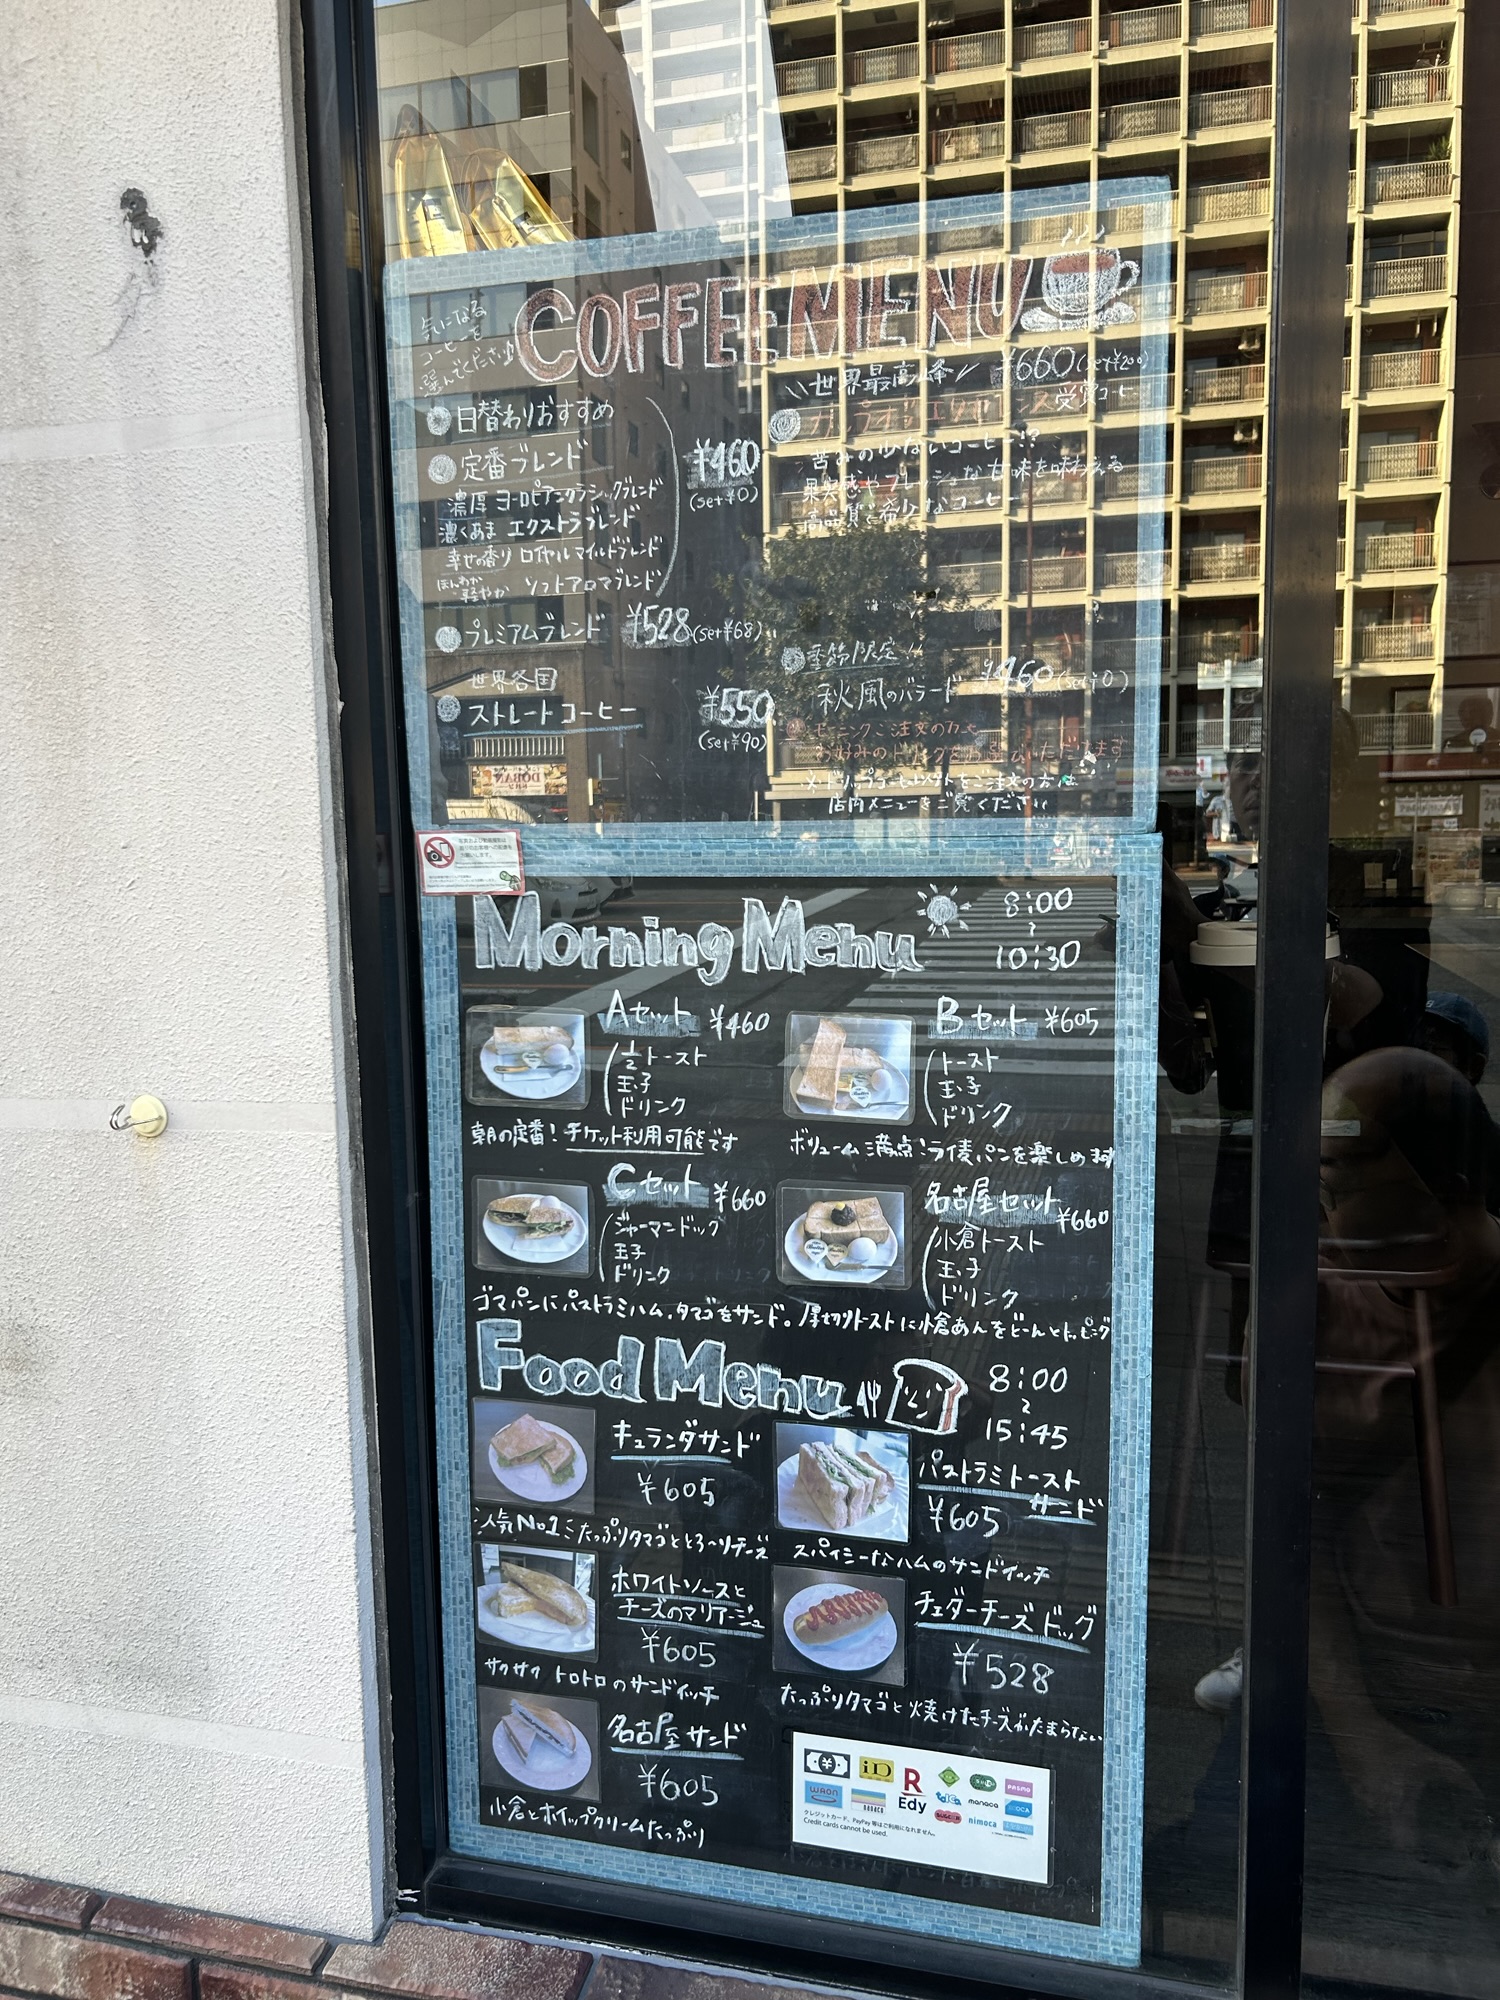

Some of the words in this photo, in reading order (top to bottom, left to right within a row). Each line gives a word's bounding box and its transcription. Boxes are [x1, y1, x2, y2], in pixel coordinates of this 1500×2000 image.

[515, 276, 780, 383] COFFEE
[788, 254, 1033, 360] MENU
[457, 395, 615, 433] 日替わりおすすめ
[461, 439, 589, 482] 定番ブレンド
[693, 438, 761, 483] ¥460
[465, 612, 606, 648] プレミアムブレンド
[626, 602, 693, 645] ¥528
[470, 667, 559, 694] 世界各国
[468, 699, 637, 726] ストレートコーヒー
[702, 684, 775, 725] ¥550
[1004, 887, 1073, 918] 8:00
[473, 891, 734, 986] Morning
[741, 895, 925, 976] Menu
[996, 940, 1081, 971] 10:30
[606, 989, 692, 1028] Aセット
[710, 1004, 771, 1041] ¥460
[936, 995, 1028, 1037] Bセット
[1045, 1005, 1099, 1036] ¥605
[942, 1047, 999, 1076] トースト
[622, 1096, 686, 1119] ドリンク
[942, 1102, 1012, 1129] ドリンク
[607, 1162, 702, 1200] Cセット
[713, 1181, 767, 1213] ¥660
[924, 1176, 1065, 1217] 名古屋セット
[1055, 1207, 1110, 1234] ¥660
[934, 1221, 1045, 1254] 小倉トースト
[615, 1263, 671, 1287] ドリンク
[942, 1283, 1019, 1310] ドリンク
[476, 1318, 647, 1403] Food
[654, 1336, 855, 1420] Menu
[989, 1364, 1068, 1393] 8:00
[612, 1419, 761, 1458] キュランダサンド
[985, 1416, 1069, 1450] 15:45
[919, 1449, 1081, 1492] パストラミトースト
[637, 1472, 716, 1507] ¥605
[1029, 1492, 1105, 1520] サンド
[928, 1494, 1001, 1538] ¥605
[611, 1564, 746, 1599] ホワイトソースと
[618, 1598, 766, 1628] チーズのマリアージュ
[641, 1626, 717, 1668] ¥605
[953, 1638, 1055, 1694] ¥528
[607, 1711, 748, 1750] 名古屋サンド
[638, 1763, 719, 1806] ¥605
[863, 1759, 892, 1778] iD
[899, 1797, 927, 1815] Edy
[968, 1798, 999, 1809] manaca
[803, 1817, 822, 1826] Credit
[822, 1821, 839, 1829] cards
[840, 1824, 861, 1833] cannot
[852, 1818, 871, 1827] PayPay
[968, 1817, 997, 1828] nimoca
